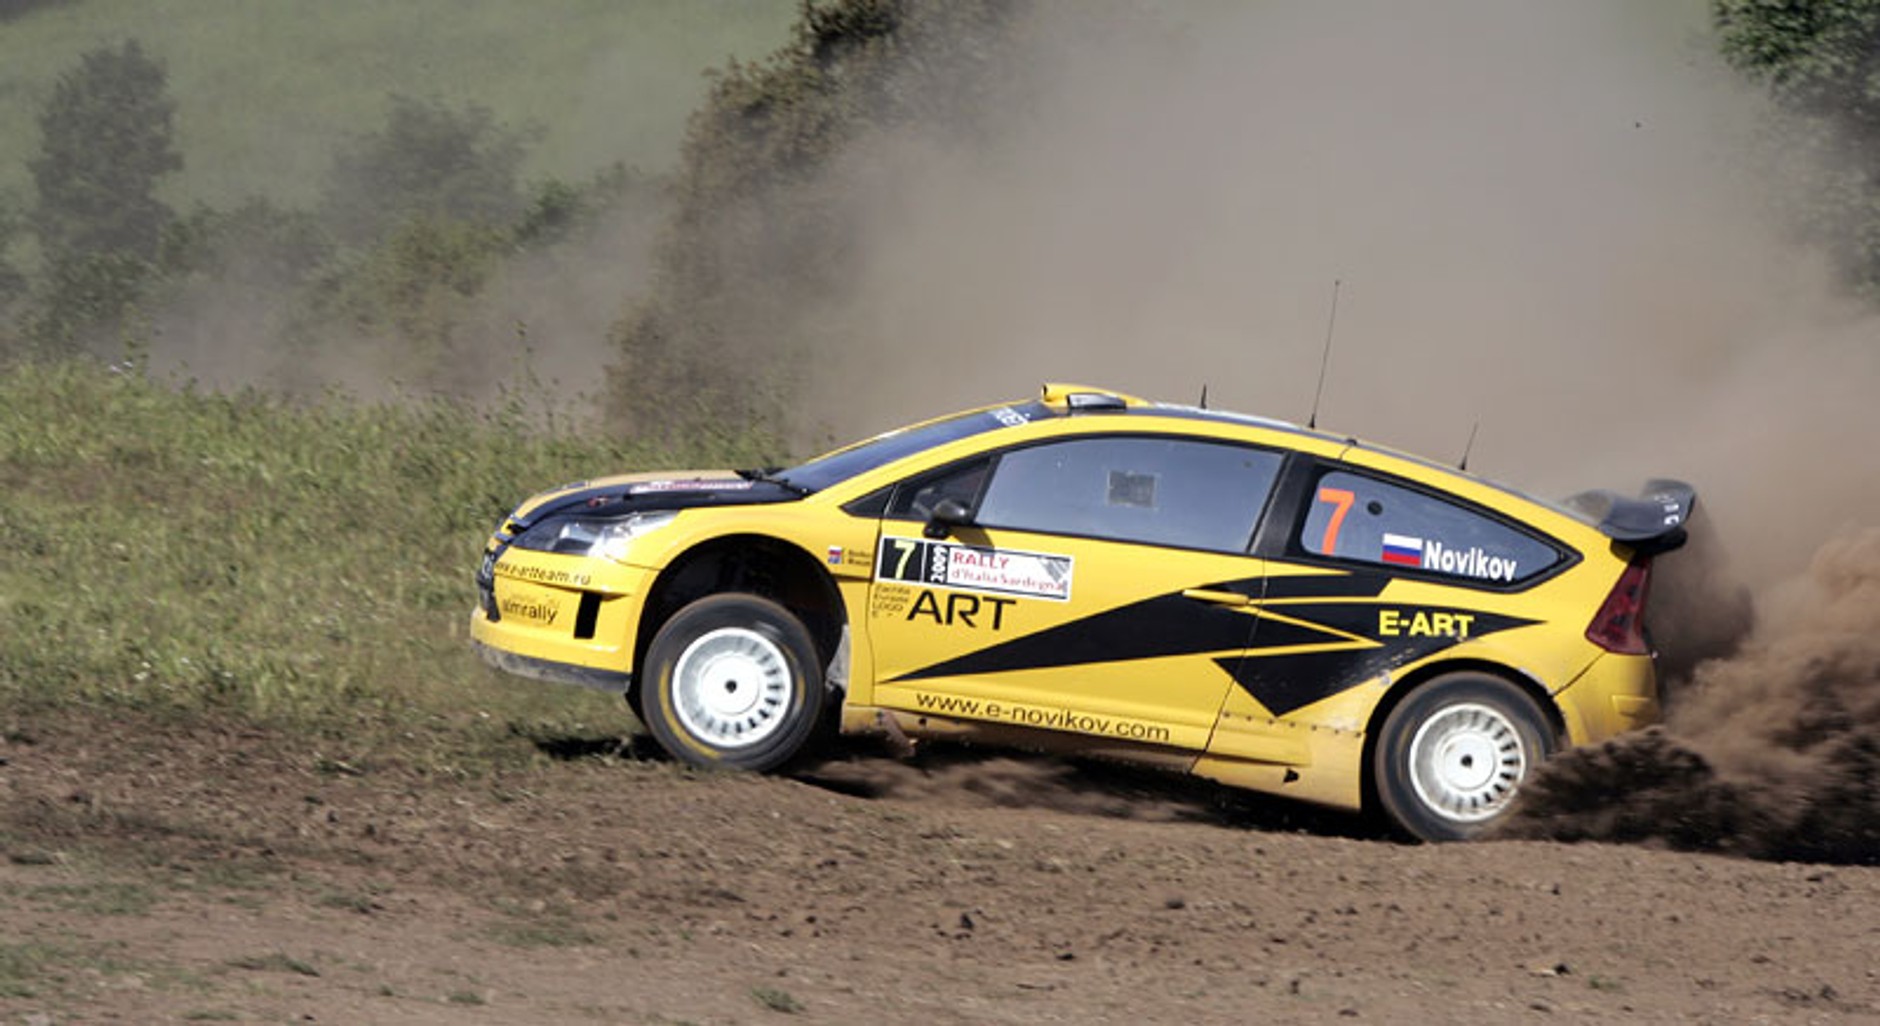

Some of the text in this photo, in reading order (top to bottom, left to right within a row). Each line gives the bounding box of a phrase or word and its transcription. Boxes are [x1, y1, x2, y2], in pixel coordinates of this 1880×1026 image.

[1318, 487, 1355, 556] 7
[894, 539, 916, 579] 7
[930, 544, 949, 583] 2009
[953, 551, 1010, 570] RALLY
[1424, 540, 1518, 583] Novikov
[906, 589, 1017, 630] ART
[1378, 609, 1475, 638] E-ART
[916, 692, 1171, 742] www.e-novikov.com
